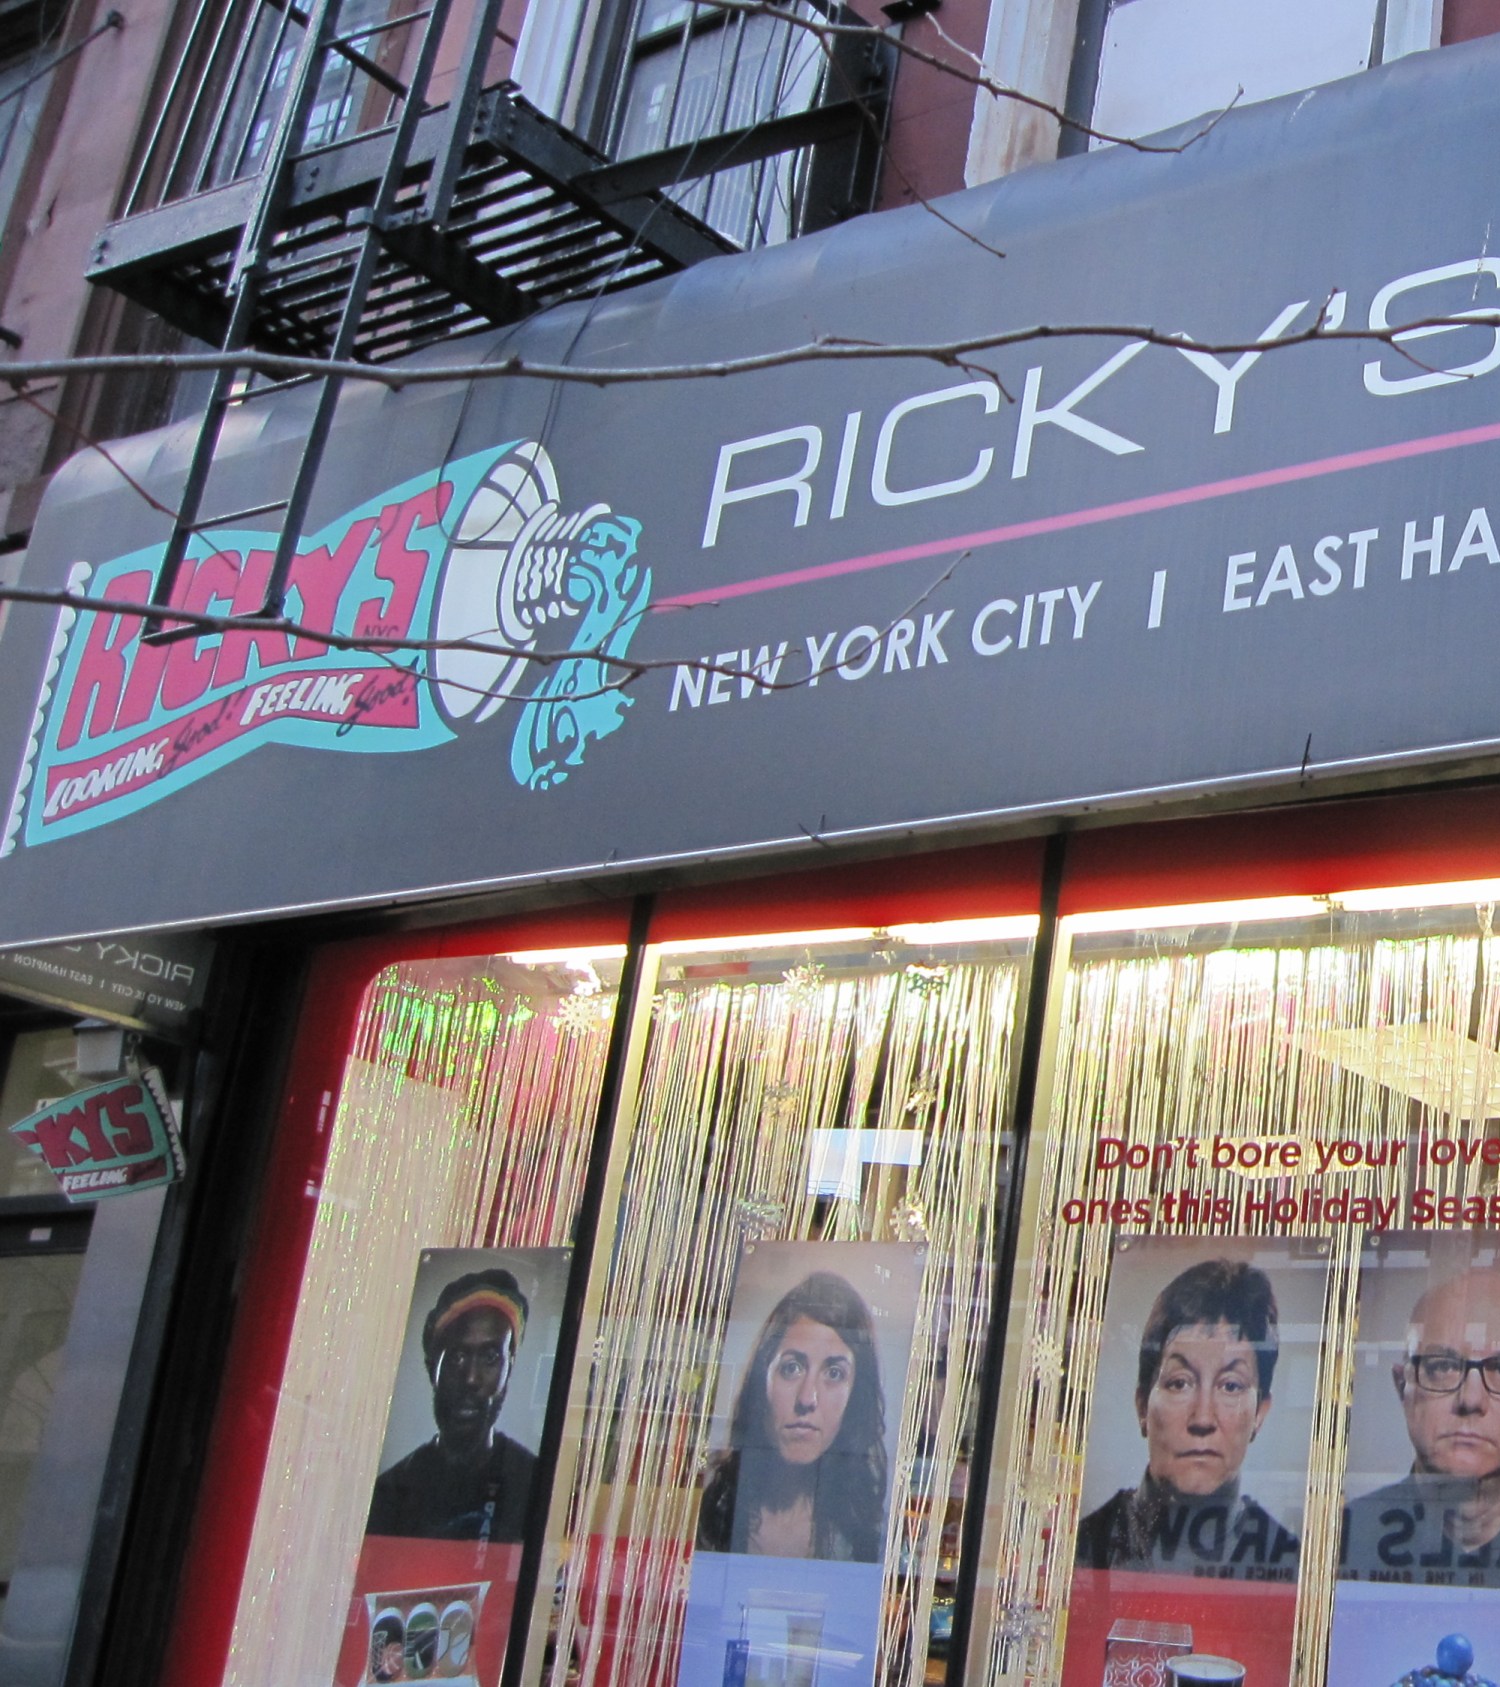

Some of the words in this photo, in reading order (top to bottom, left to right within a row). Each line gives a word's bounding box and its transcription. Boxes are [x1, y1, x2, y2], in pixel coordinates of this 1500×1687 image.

[57, 481, 454, 750] RICKY'S
[669, 642, 787, 712] NEW
[805, 609, 953, 687] YORK
[971, 580, 1102, 655] CITY
[1223, 529, 1378, 612] EAST
[43, 737, 171, 817] LOOKING
[240, 673, 364, 725] FEELING
[1062, 1198, 1151, 1225] ones
[1161, 1189, 1231, 1225] this
[1244, 1189, 1397, 1231] Holiday
[1099, 1136, 1199, 1171] Don't
[1211, 1133, 1300, 1169] bore
[1315, 1140, 1406, 1174] your
